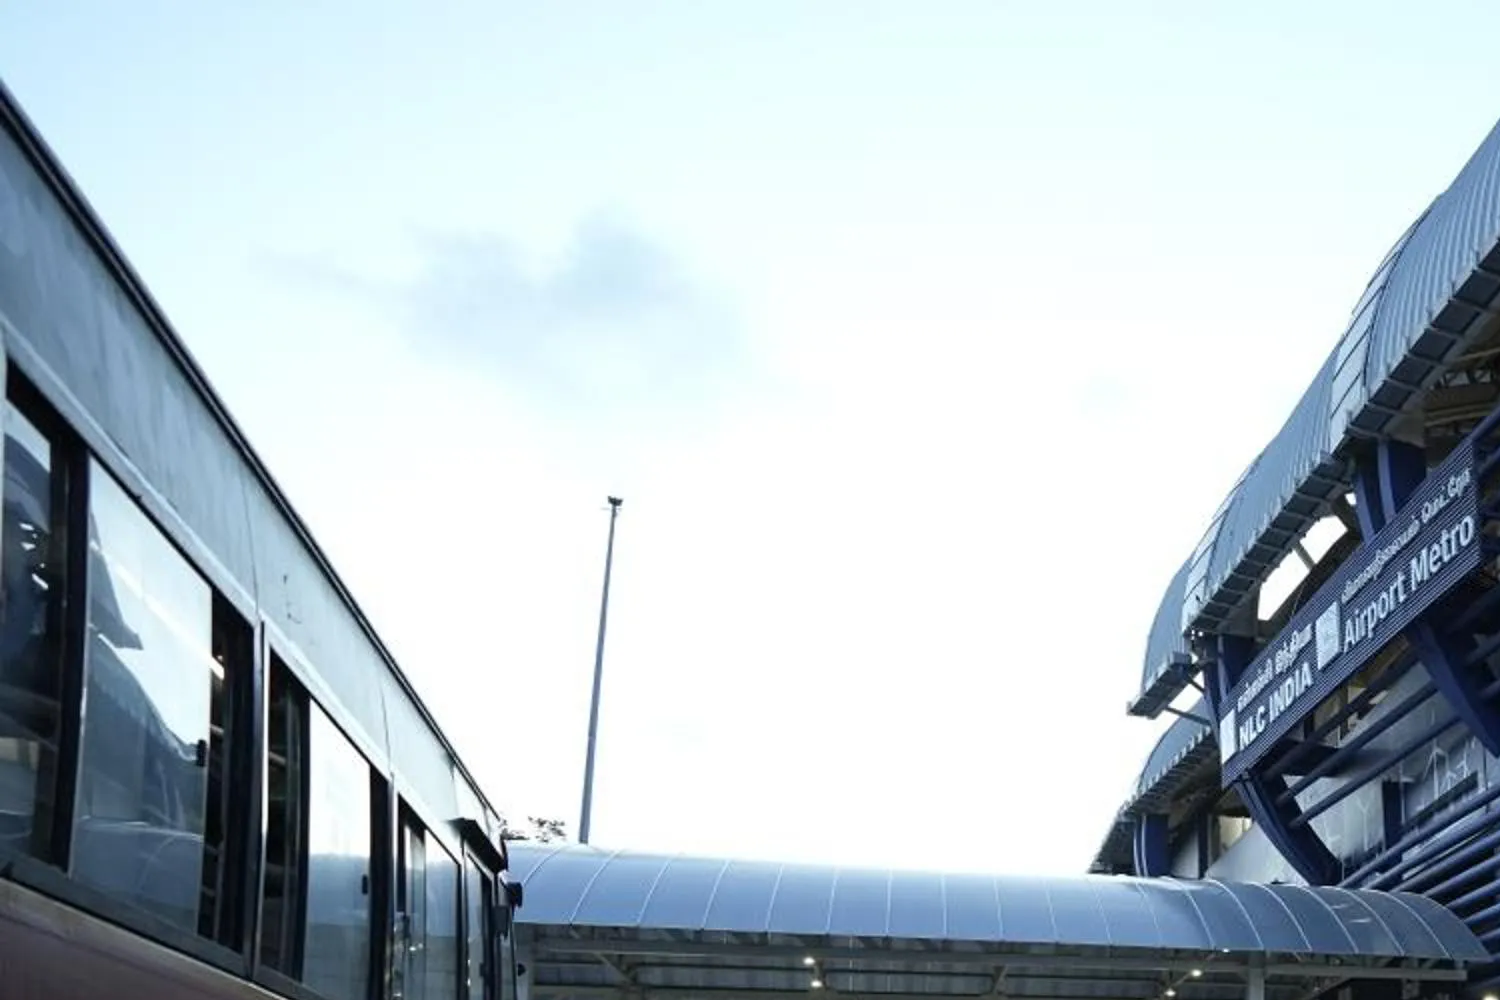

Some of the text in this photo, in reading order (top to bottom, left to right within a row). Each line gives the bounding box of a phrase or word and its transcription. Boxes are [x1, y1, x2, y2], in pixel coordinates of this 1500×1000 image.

[1343, 514, 1475, 652] Airport Metro
[1239, 662, 1314, 750] NLC INDIA
